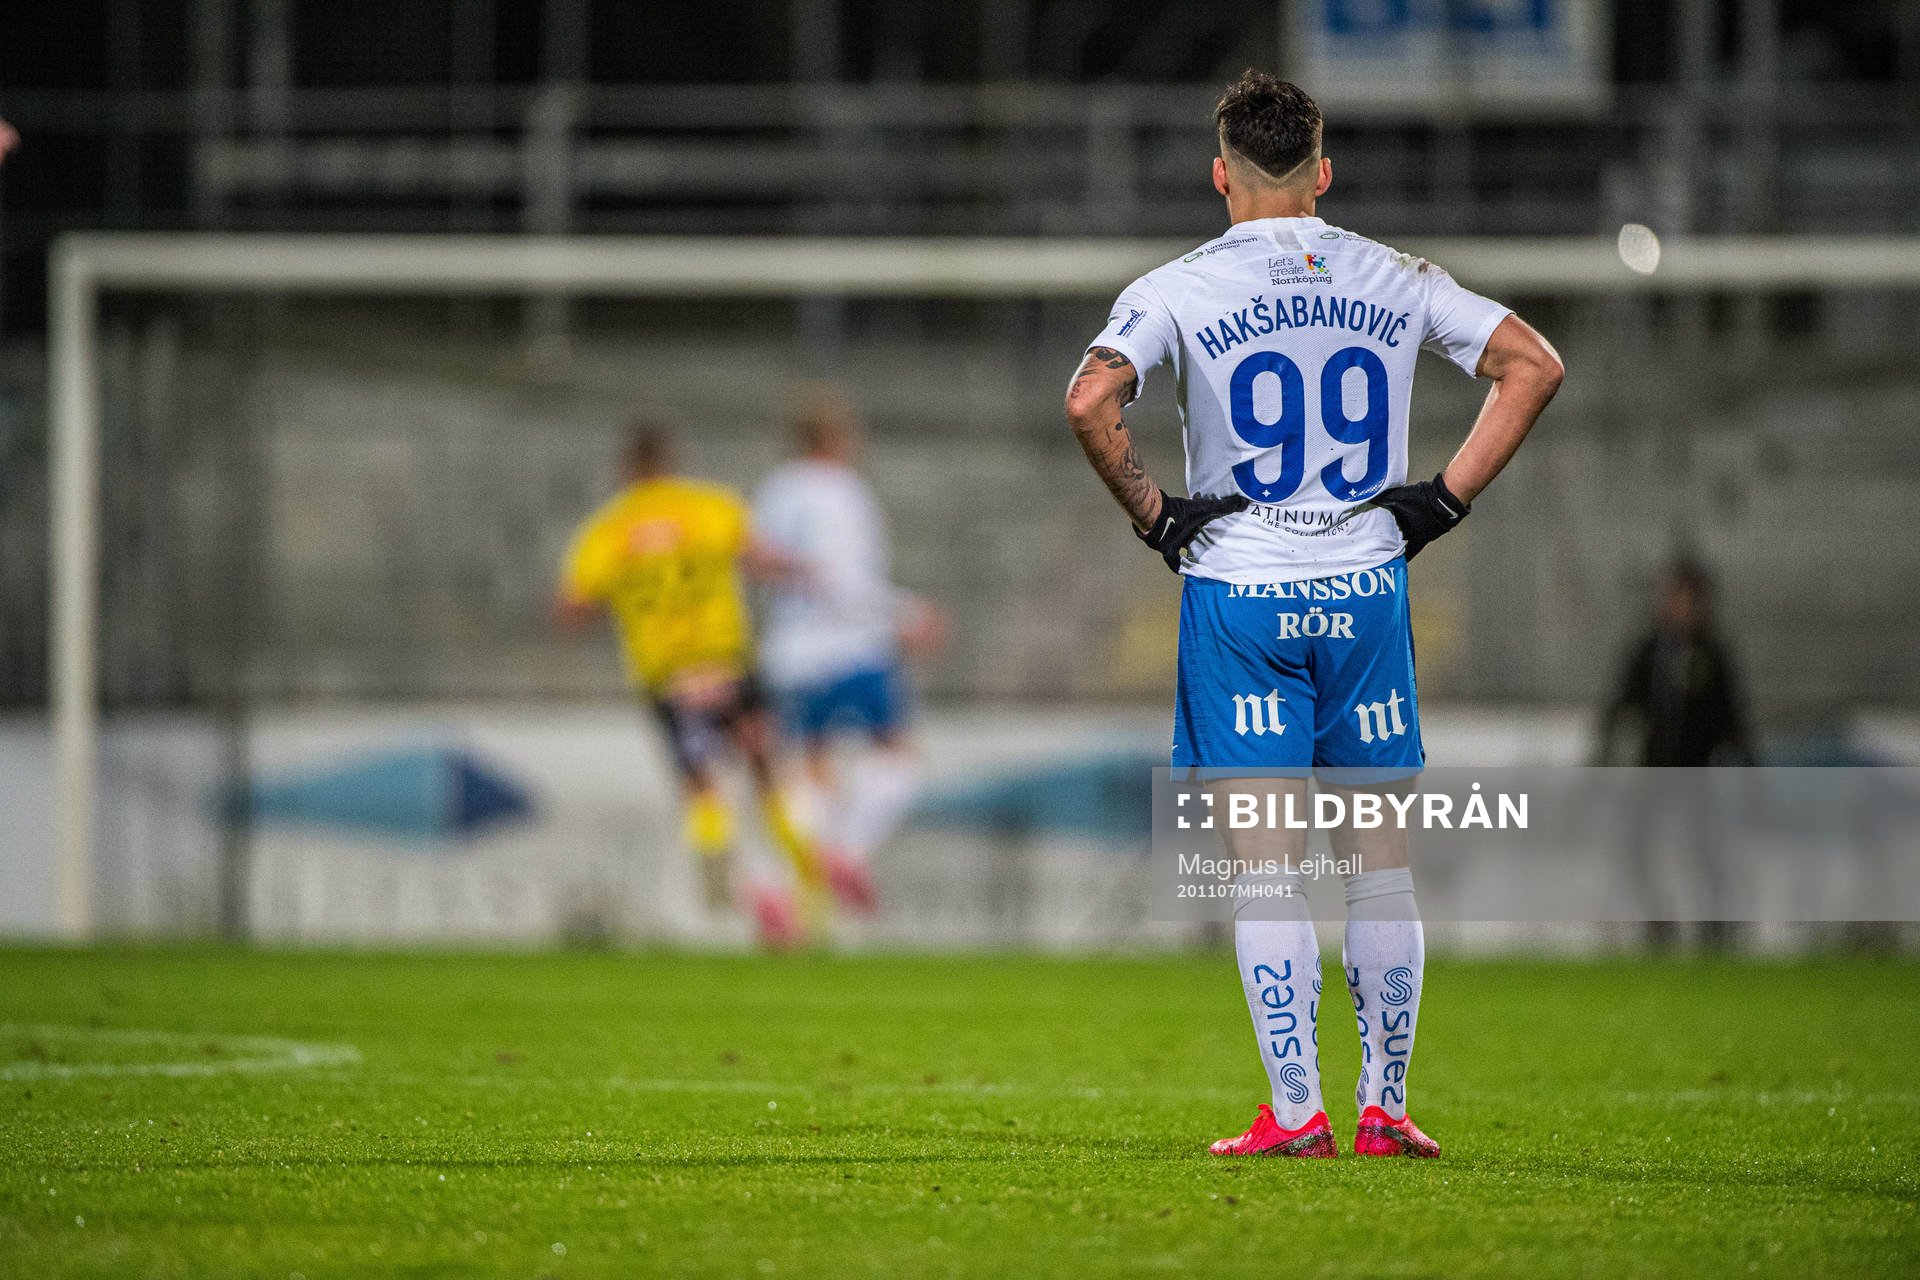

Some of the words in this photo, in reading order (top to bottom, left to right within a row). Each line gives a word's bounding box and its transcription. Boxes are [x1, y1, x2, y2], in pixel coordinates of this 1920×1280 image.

[1268, 257, 1294, 268] Let's
[1270, 265, 1304, 277] create
[1271, 275, 1332, 285] Norrköping
[1196, 295, 1410, 360] HAKŠABANOVIĆ
[1230, 347, 1389, 503] 99
[1276, 606, 1356, 640] RÖR
